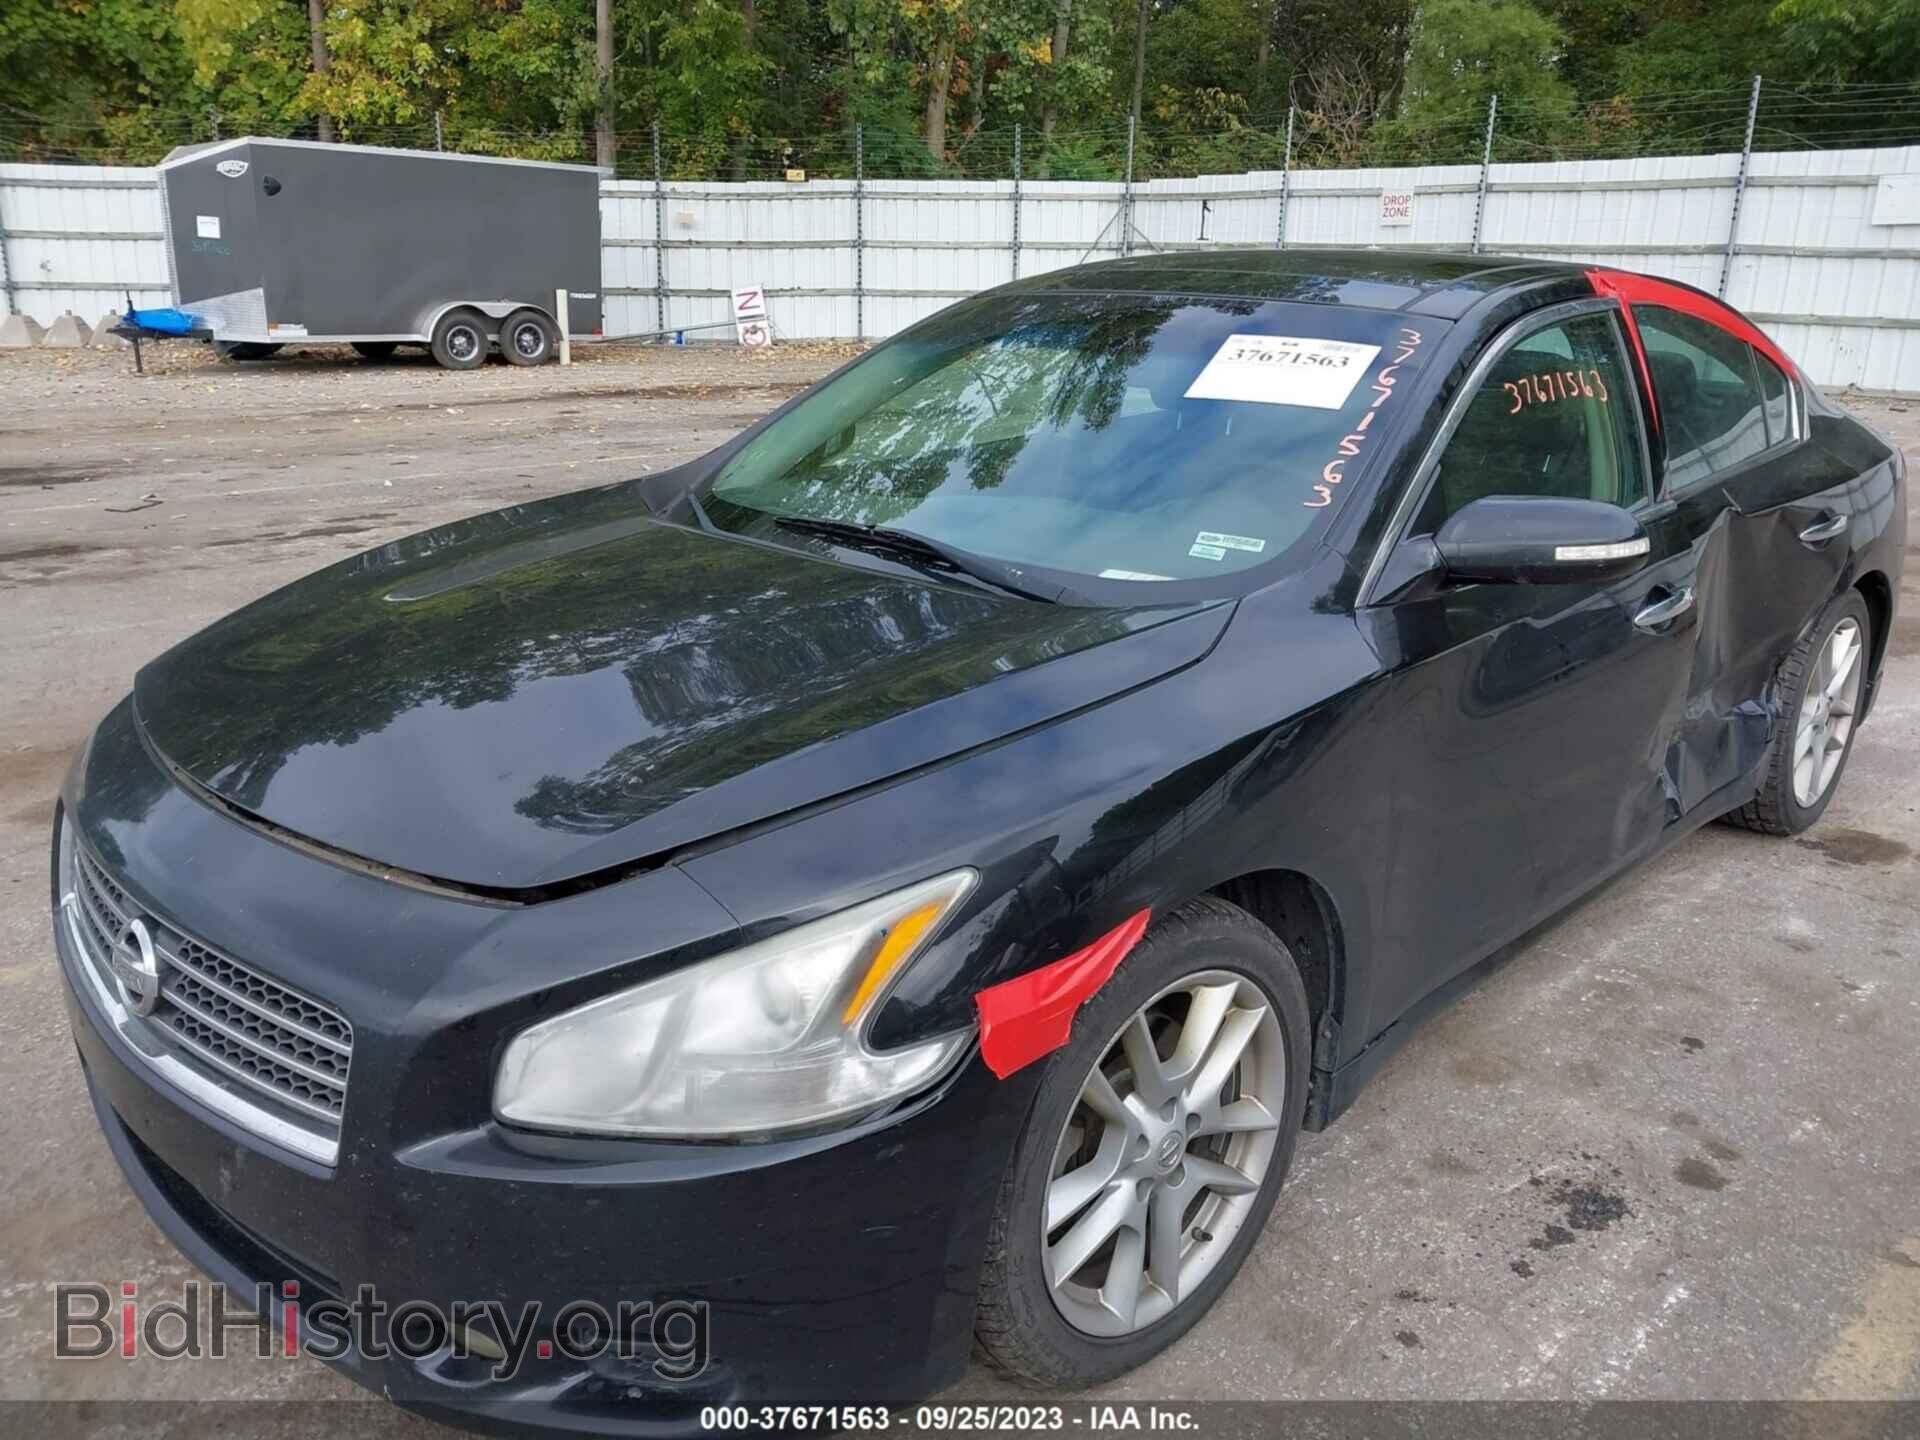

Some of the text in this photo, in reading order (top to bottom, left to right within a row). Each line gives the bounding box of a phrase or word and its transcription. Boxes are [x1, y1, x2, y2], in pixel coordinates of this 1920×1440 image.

[1384, 195, 1411, 206] DROP
[1383, 207, 1409, 217] ZONE
[1228, 348, 1350, 368] 37671563
[1504, 369, 1608, 414] 37671563
[1303, 328, 1423, 507] 37671563
